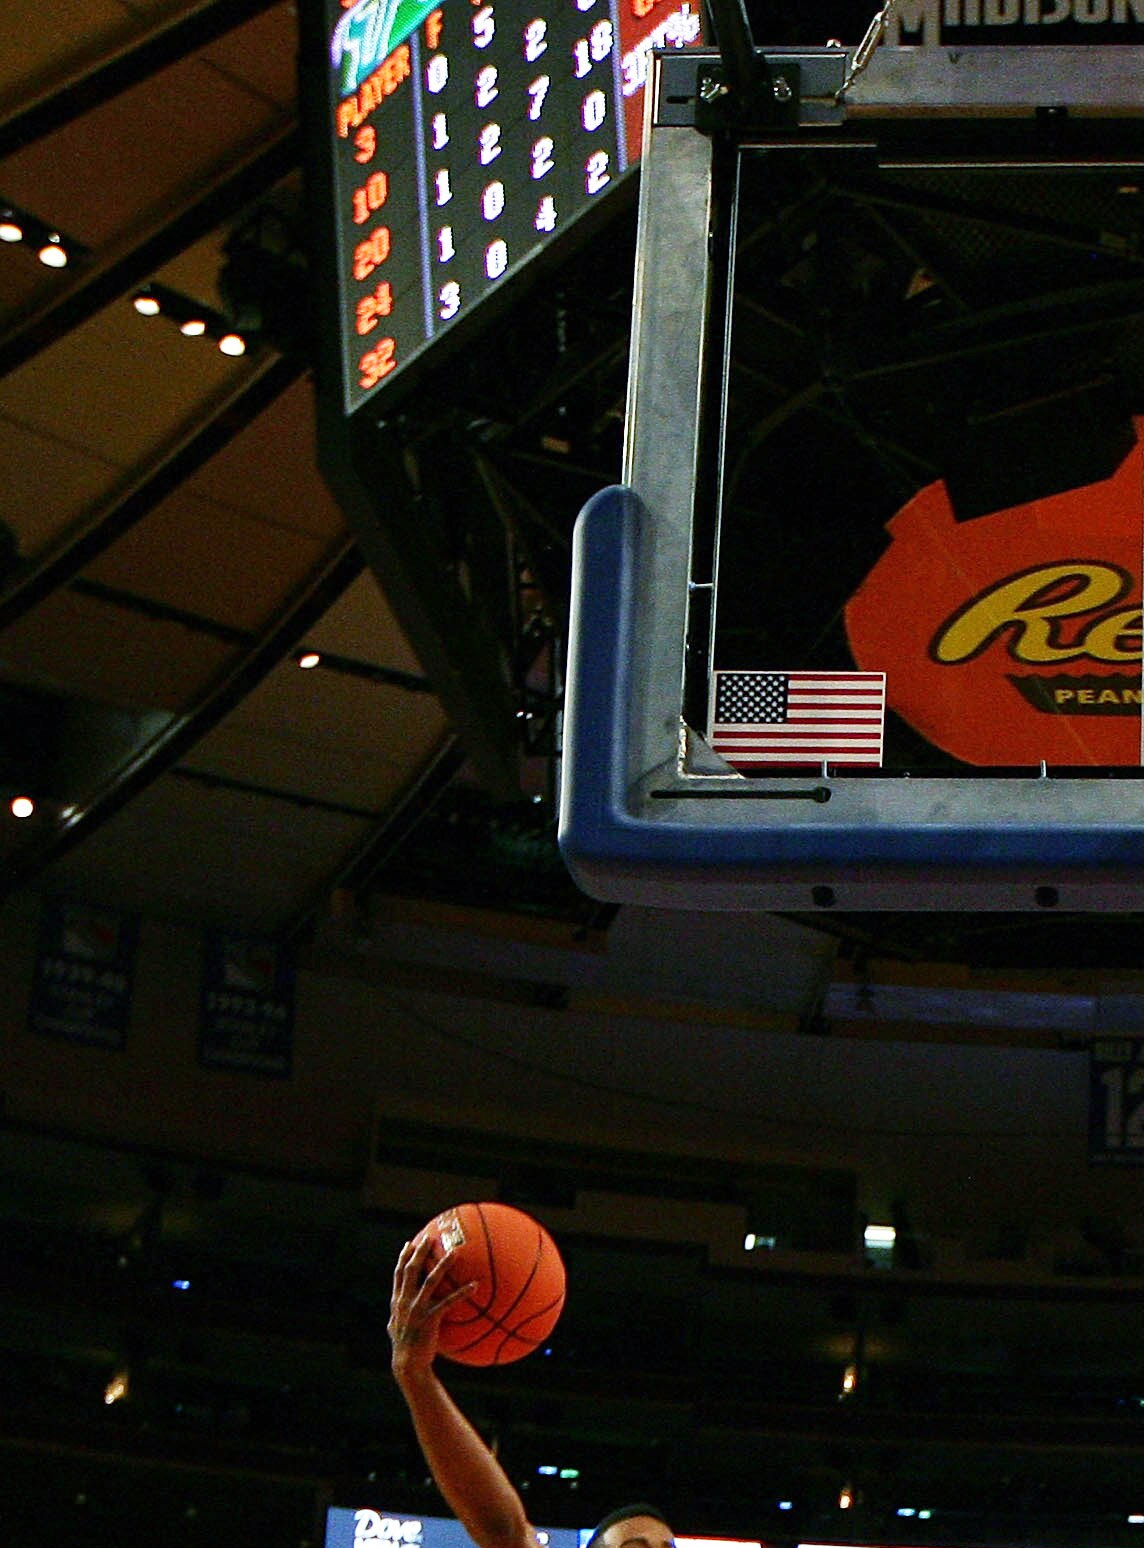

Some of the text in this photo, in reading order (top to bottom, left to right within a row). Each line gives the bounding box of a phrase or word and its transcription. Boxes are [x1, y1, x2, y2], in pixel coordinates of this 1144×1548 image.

[352, 17, 549, 225] 10 1 2 2
[426, 53, 450, 94] 0
[472, 5, 496, 49] 5
[434, 167, 453, 207] 1
[477, 121, 503, 167] 2
[527, 74, 551, 121] 7
[571, 18, 615, 79] 18
[437, 225, 456, 264] 1
[480, 179, 507, 223] 0
[529, 136, 556, 181] 2
[580, 89, 608, 132] 0
[437, 280, 462, 321] 3
[483, 237, 509, 281] 0
[533, 194, 558, 233] 4
[583, 149, 612, 196] 2
[1054, 688, 1143, 705] PEAN
